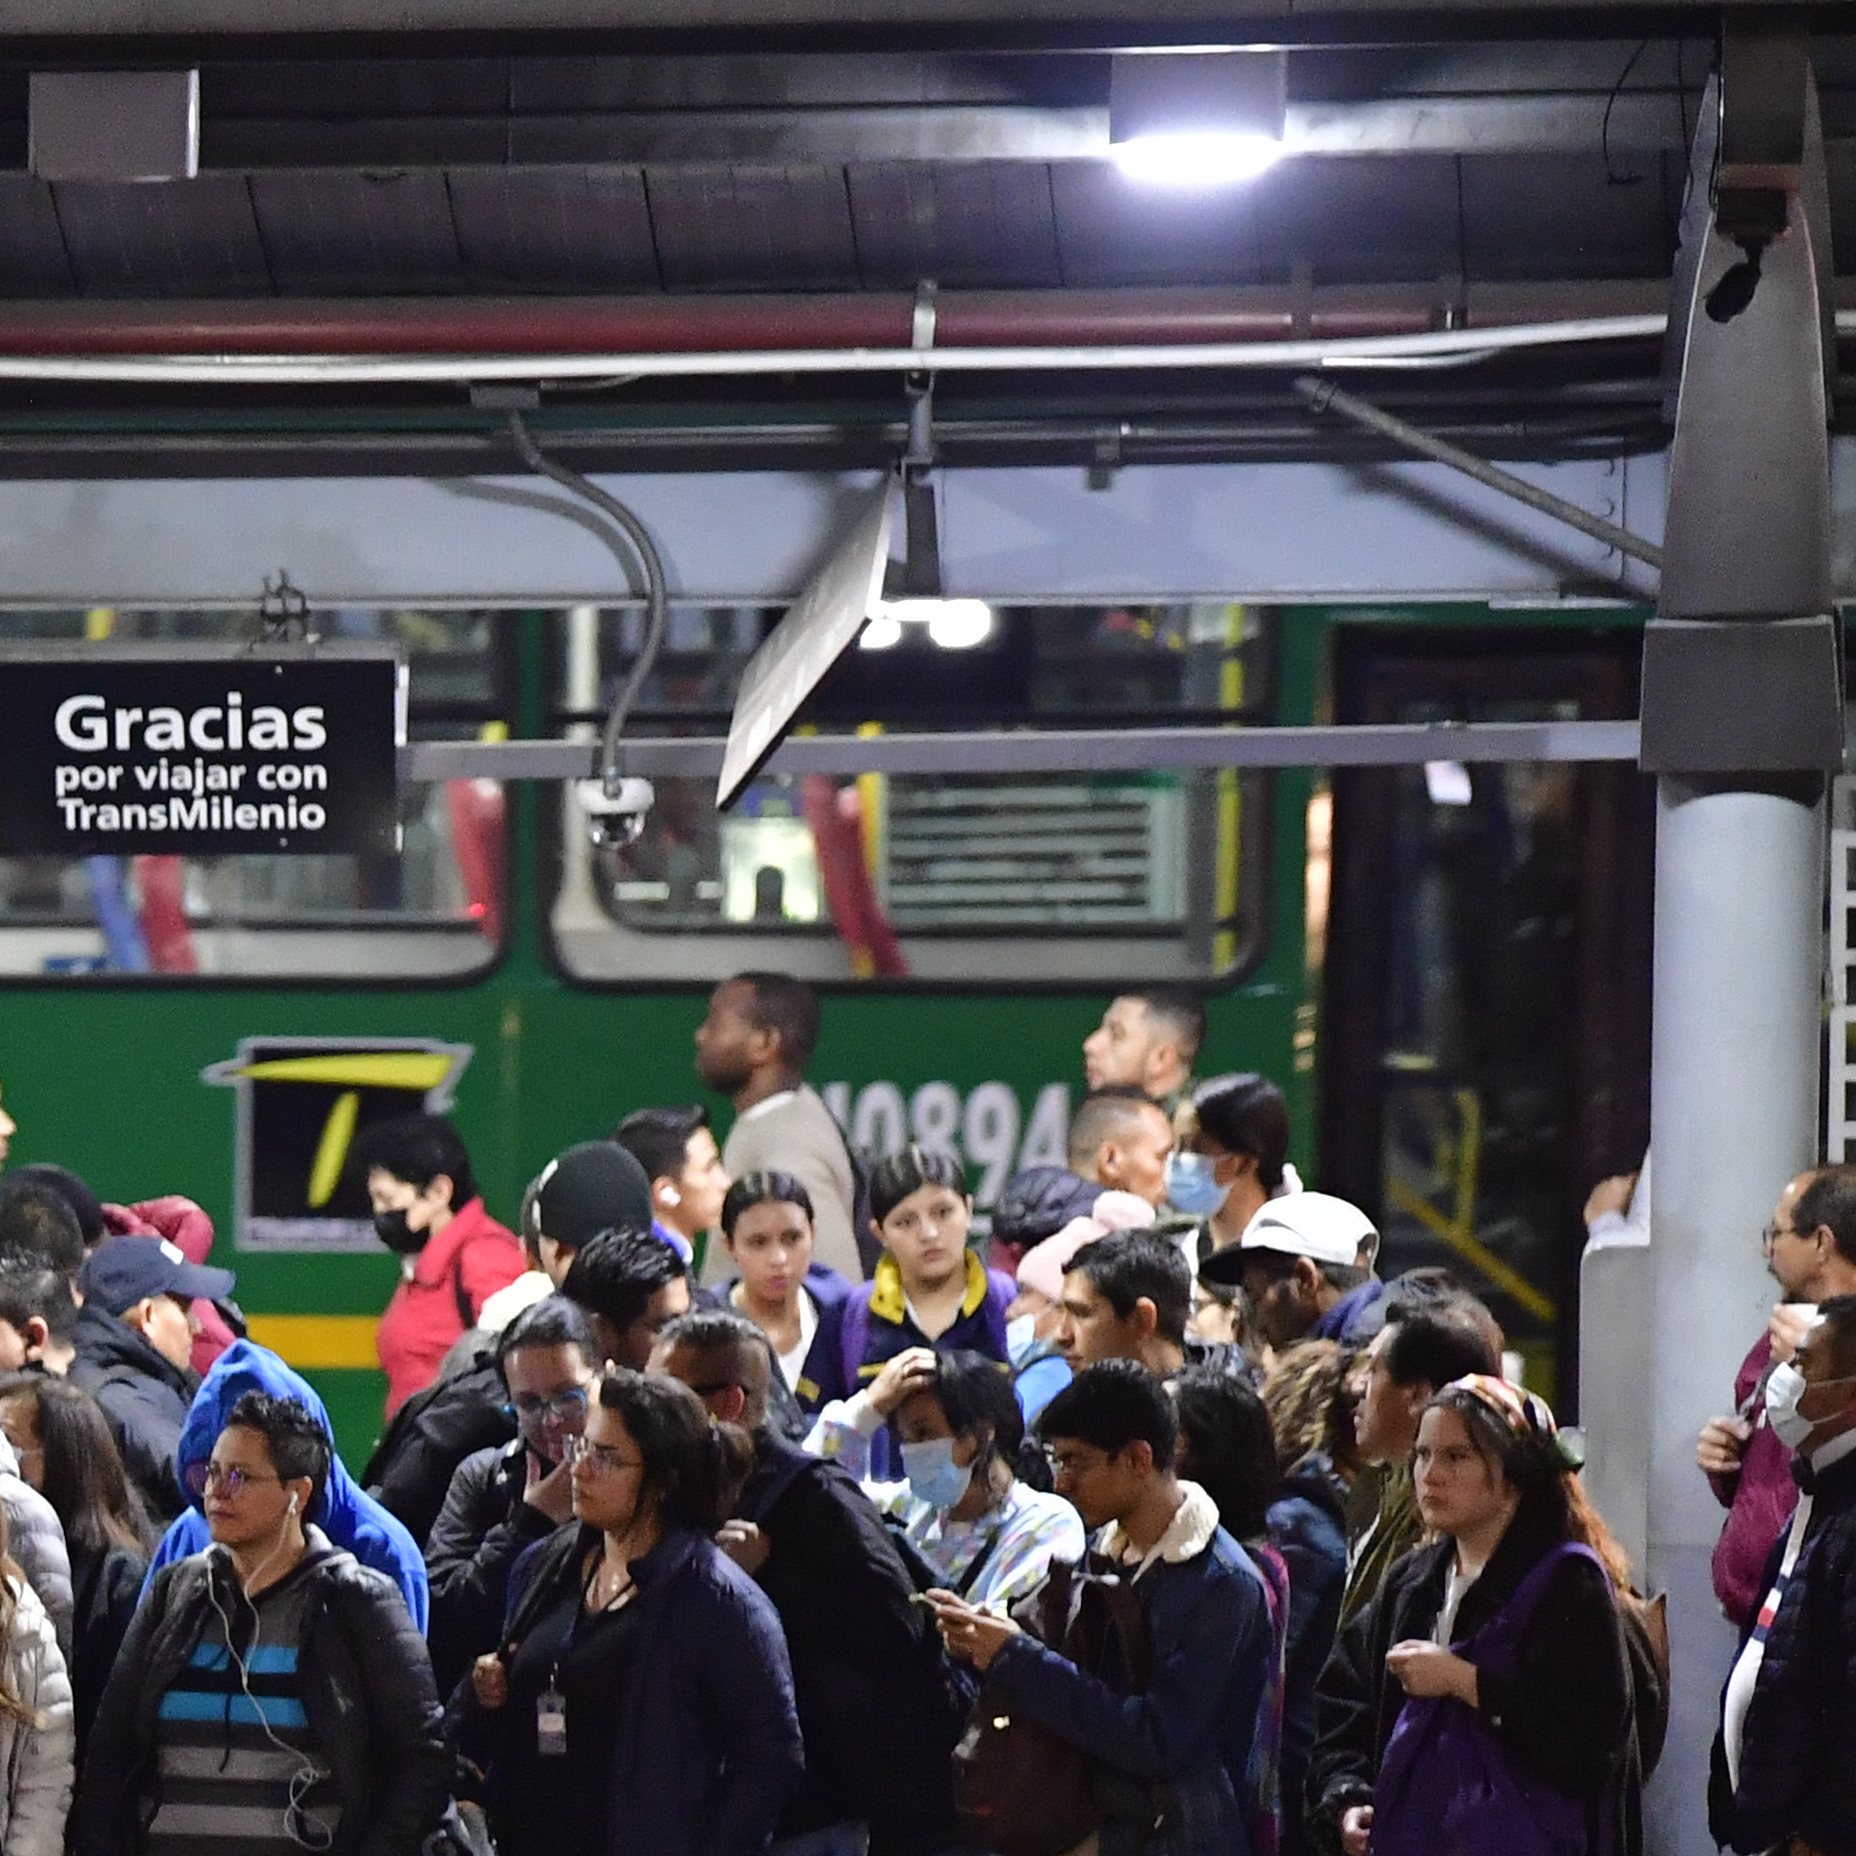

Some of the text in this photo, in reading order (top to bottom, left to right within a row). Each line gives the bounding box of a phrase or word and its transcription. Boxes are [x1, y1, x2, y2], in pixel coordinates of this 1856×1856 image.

[54, 691, 327, 751] Gracias
[55, 757, 327, 799] por viajar con
[56, 795, 326, 831] TransMilenio
